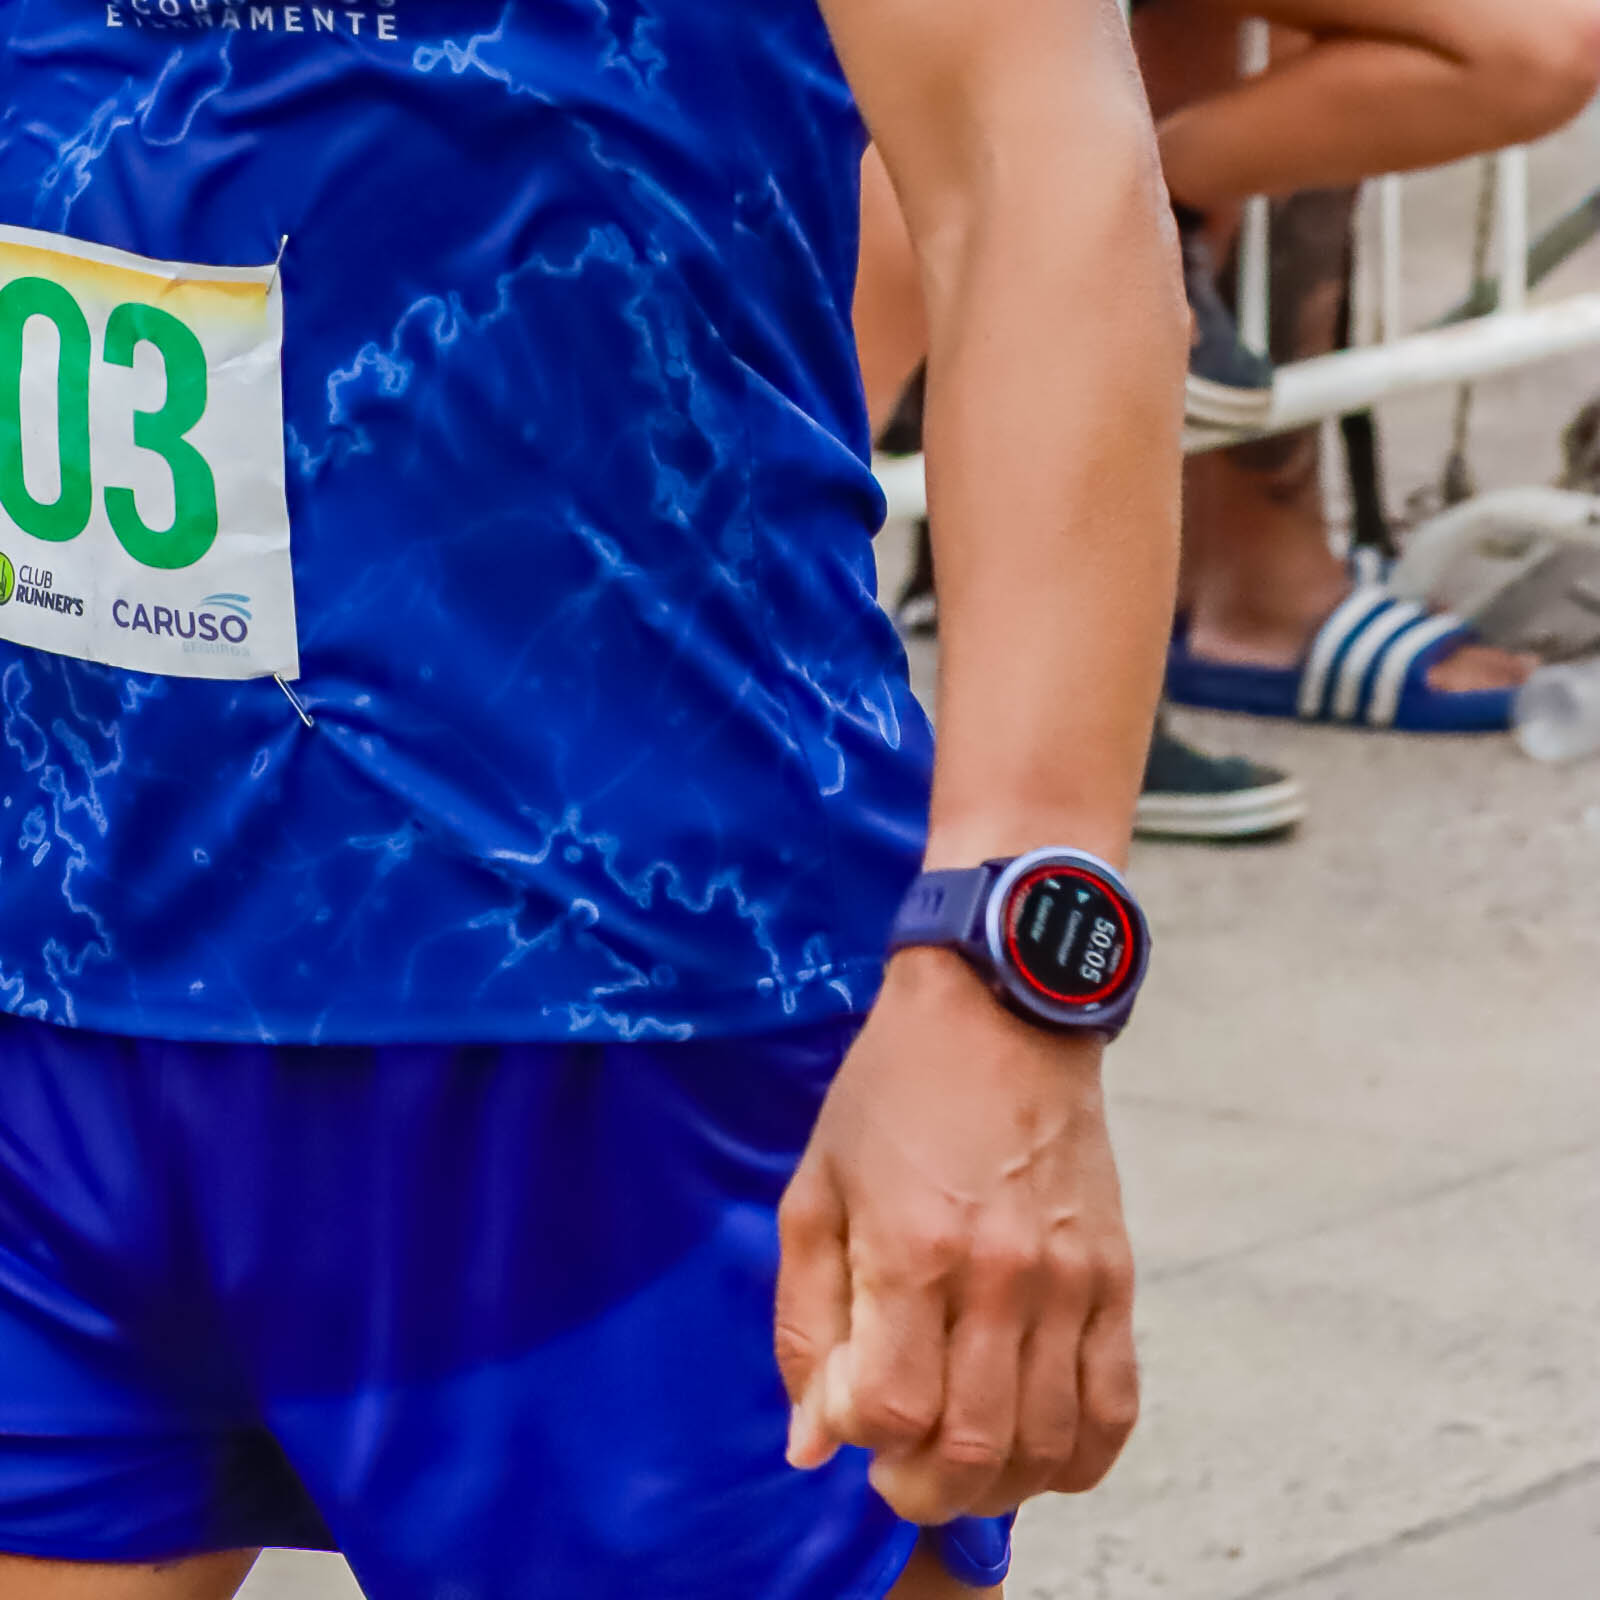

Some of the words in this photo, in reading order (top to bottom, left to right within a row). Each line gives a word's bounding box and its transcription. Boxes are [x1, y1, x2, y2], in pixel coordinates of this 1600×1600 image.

[18, 564, 53, 589] CLUB
[15, 583, 84, 617] RUNNER'S
[111, 598, 249, 644] CARUSO
[1080, 916, 1116, 984] 50:05
